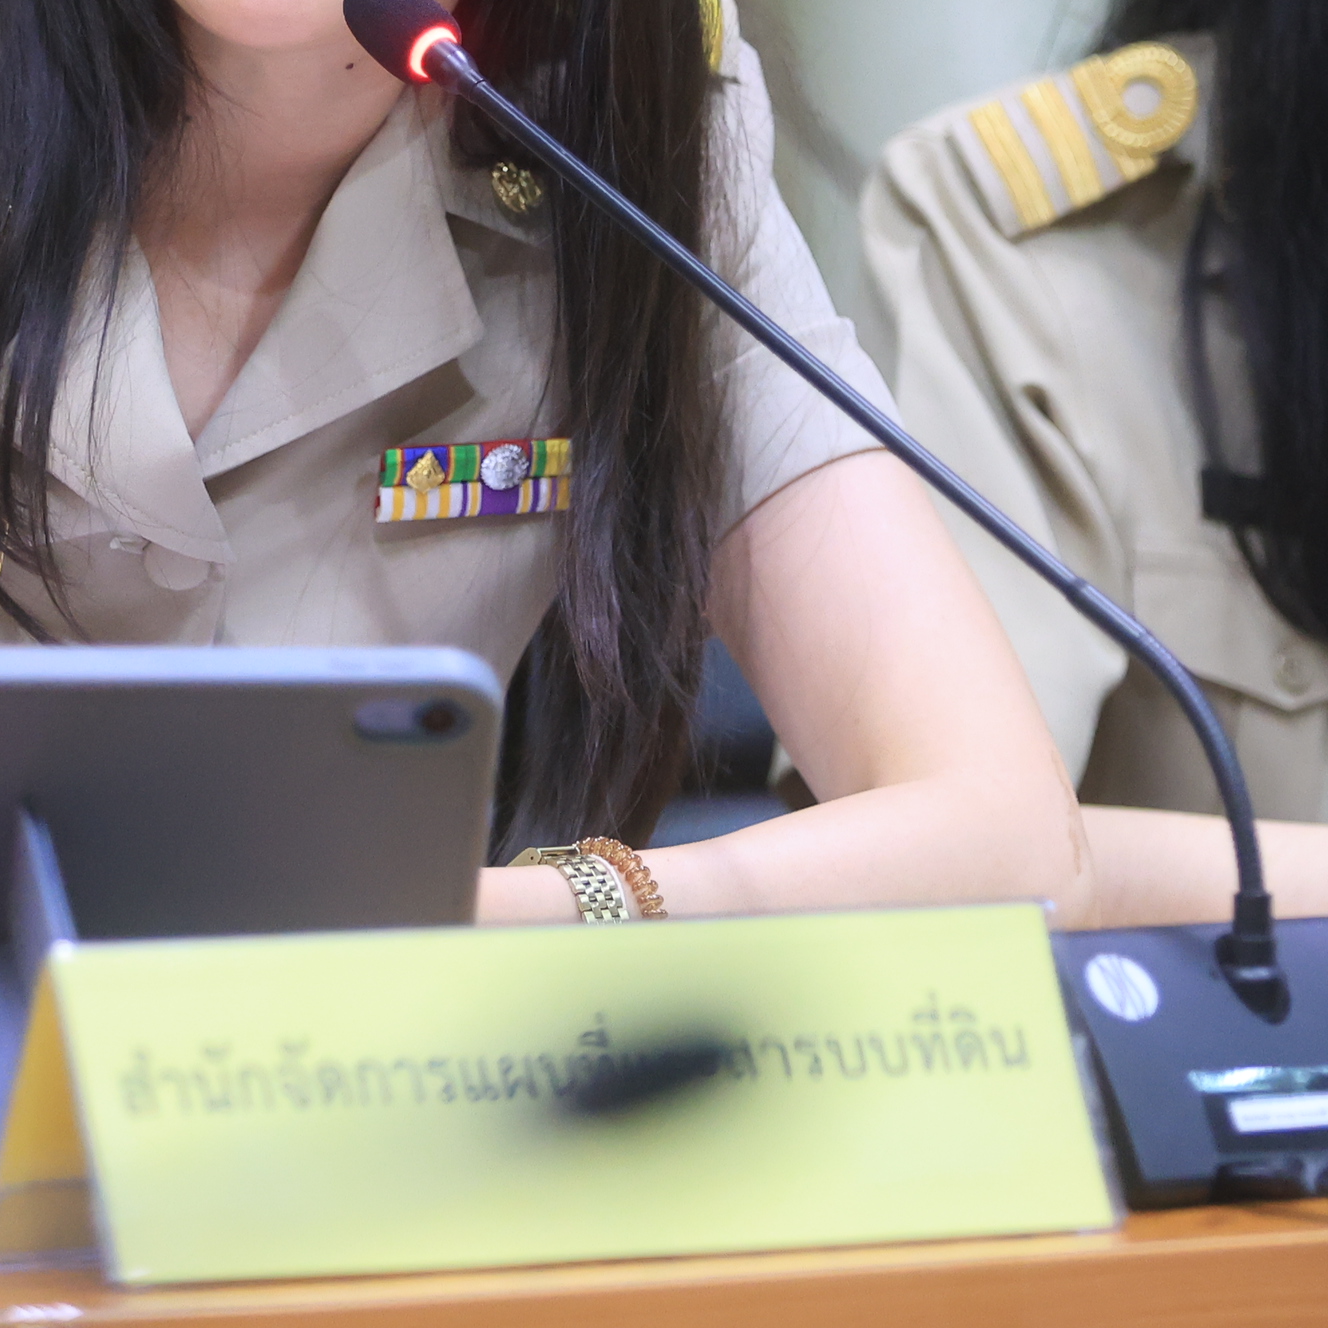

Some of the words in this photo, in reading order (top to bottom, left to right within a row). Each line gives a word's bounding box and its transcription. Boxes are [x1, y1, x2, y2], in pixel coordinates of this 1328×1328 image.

[121, 992, 1031, 1113] สำนักจัดการแผนที่สารบบที่ดิน
